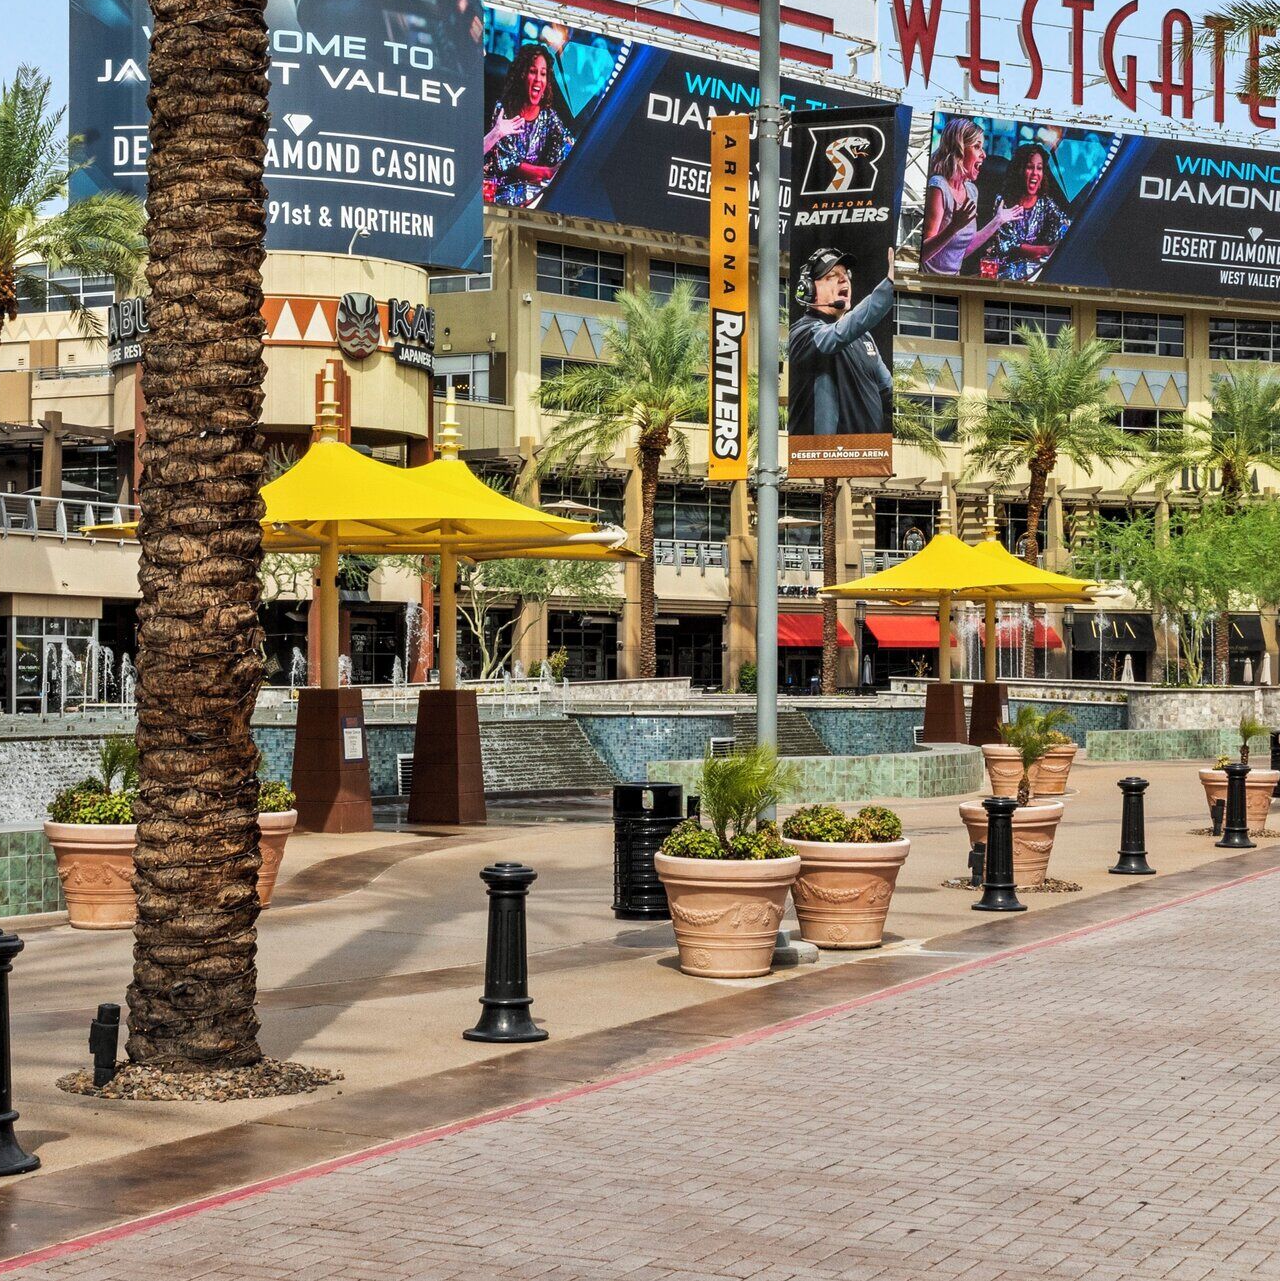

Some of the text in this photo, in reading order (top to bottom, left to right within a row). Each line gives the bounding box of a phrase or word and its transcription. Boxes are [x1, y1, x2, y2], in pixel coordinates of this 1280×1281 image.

[383, 40, 434, 70] TO
[318, 64, 467, 108] VALLEY
[685, 71, 797, 112] WINNIG
[263, 136, 456, 187] AMOND CASINO
[668, 164, 711, 194] DESE
[269, 201, 434, 238] 91st & NORTHERN
[723, 134, 738, 295] ARIZONA
[794, 207, 890, 227] RATTLERS
[812, 200, 873, 209] ARIZONA
[1162, 235, 1217, 261] DESERT
[1220, 270, 1280, 289] WEST VALLEY
[399, 347, 432, 367] JAPANESE
[714, 311, 744, 459] RATTLERS
[862, 450, 889, 458] ARENA
